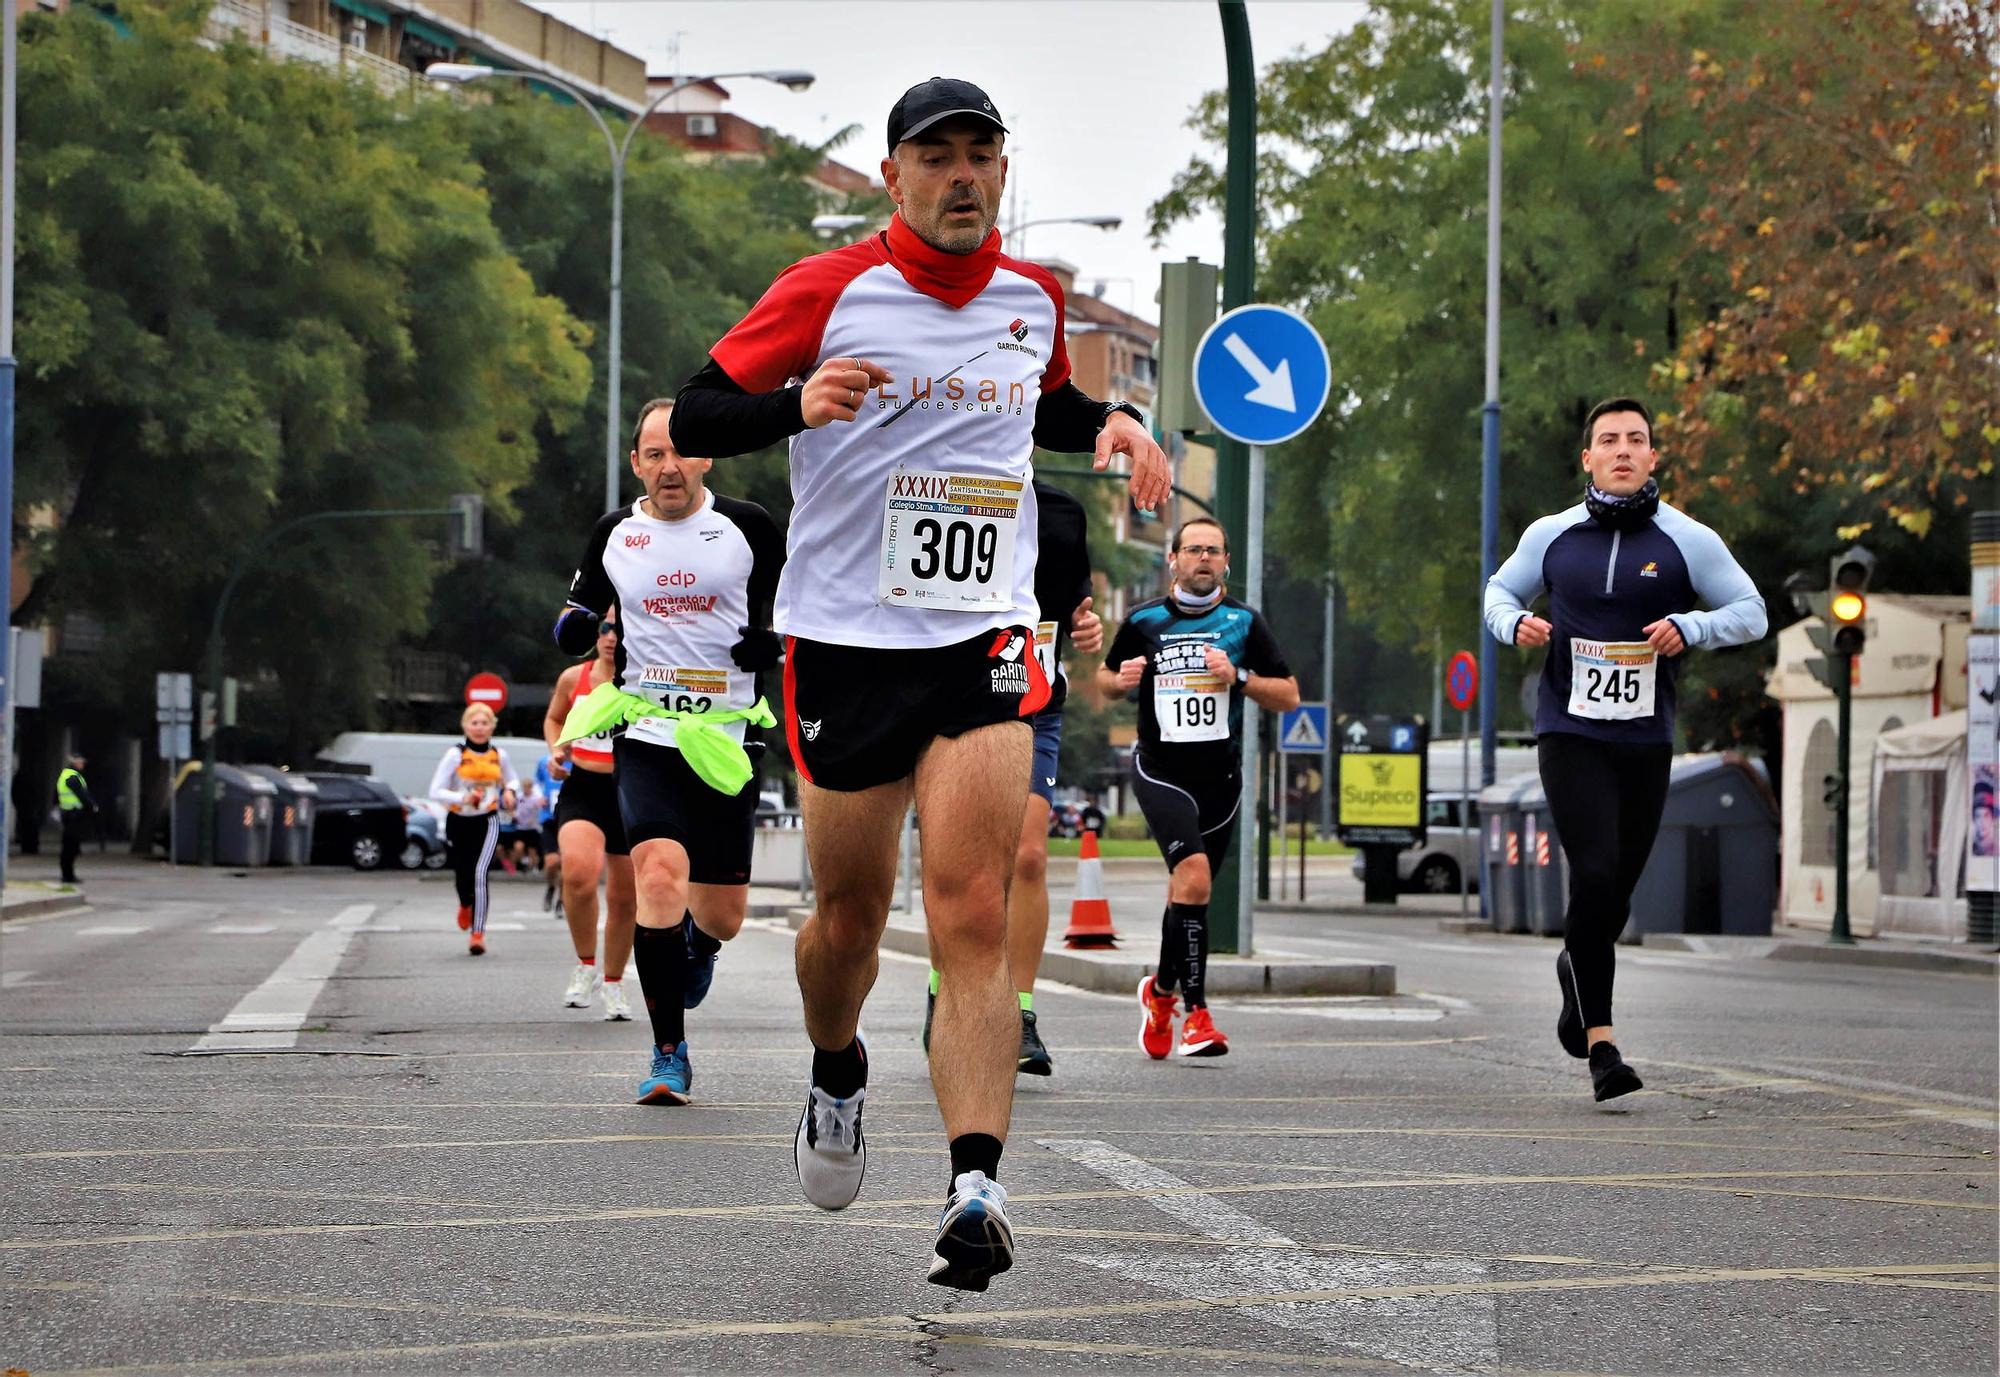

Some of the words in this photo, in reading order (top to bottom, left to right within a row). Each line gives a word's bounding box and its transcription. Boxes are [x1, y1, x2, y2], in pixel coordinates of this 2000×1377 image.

[997, 342, 1019, 352] GARITO
[892, 475, 949, 500] XXXIX
[889, 500, 915, 511] Colegio
[938, 503, 964, 513] Trinidad
[971, 506, 1017, 518] TRINITARIOS
[625, 532, 651, 550] edp
[911, 518, 998, 584] 309
[656, 569, 696, 589] edp
[670, 600, 707, 613] sevilla
[1575, 641, 1605, 659] XXXIX
[644, 667, 677, 682] XXXIX
[1587, 668, 1640, 704] 245
[1173, 696, 1216, 727] 199
[1394, 727, 1410, 749] P
[1344, 784, 1417, 807] Supeco
